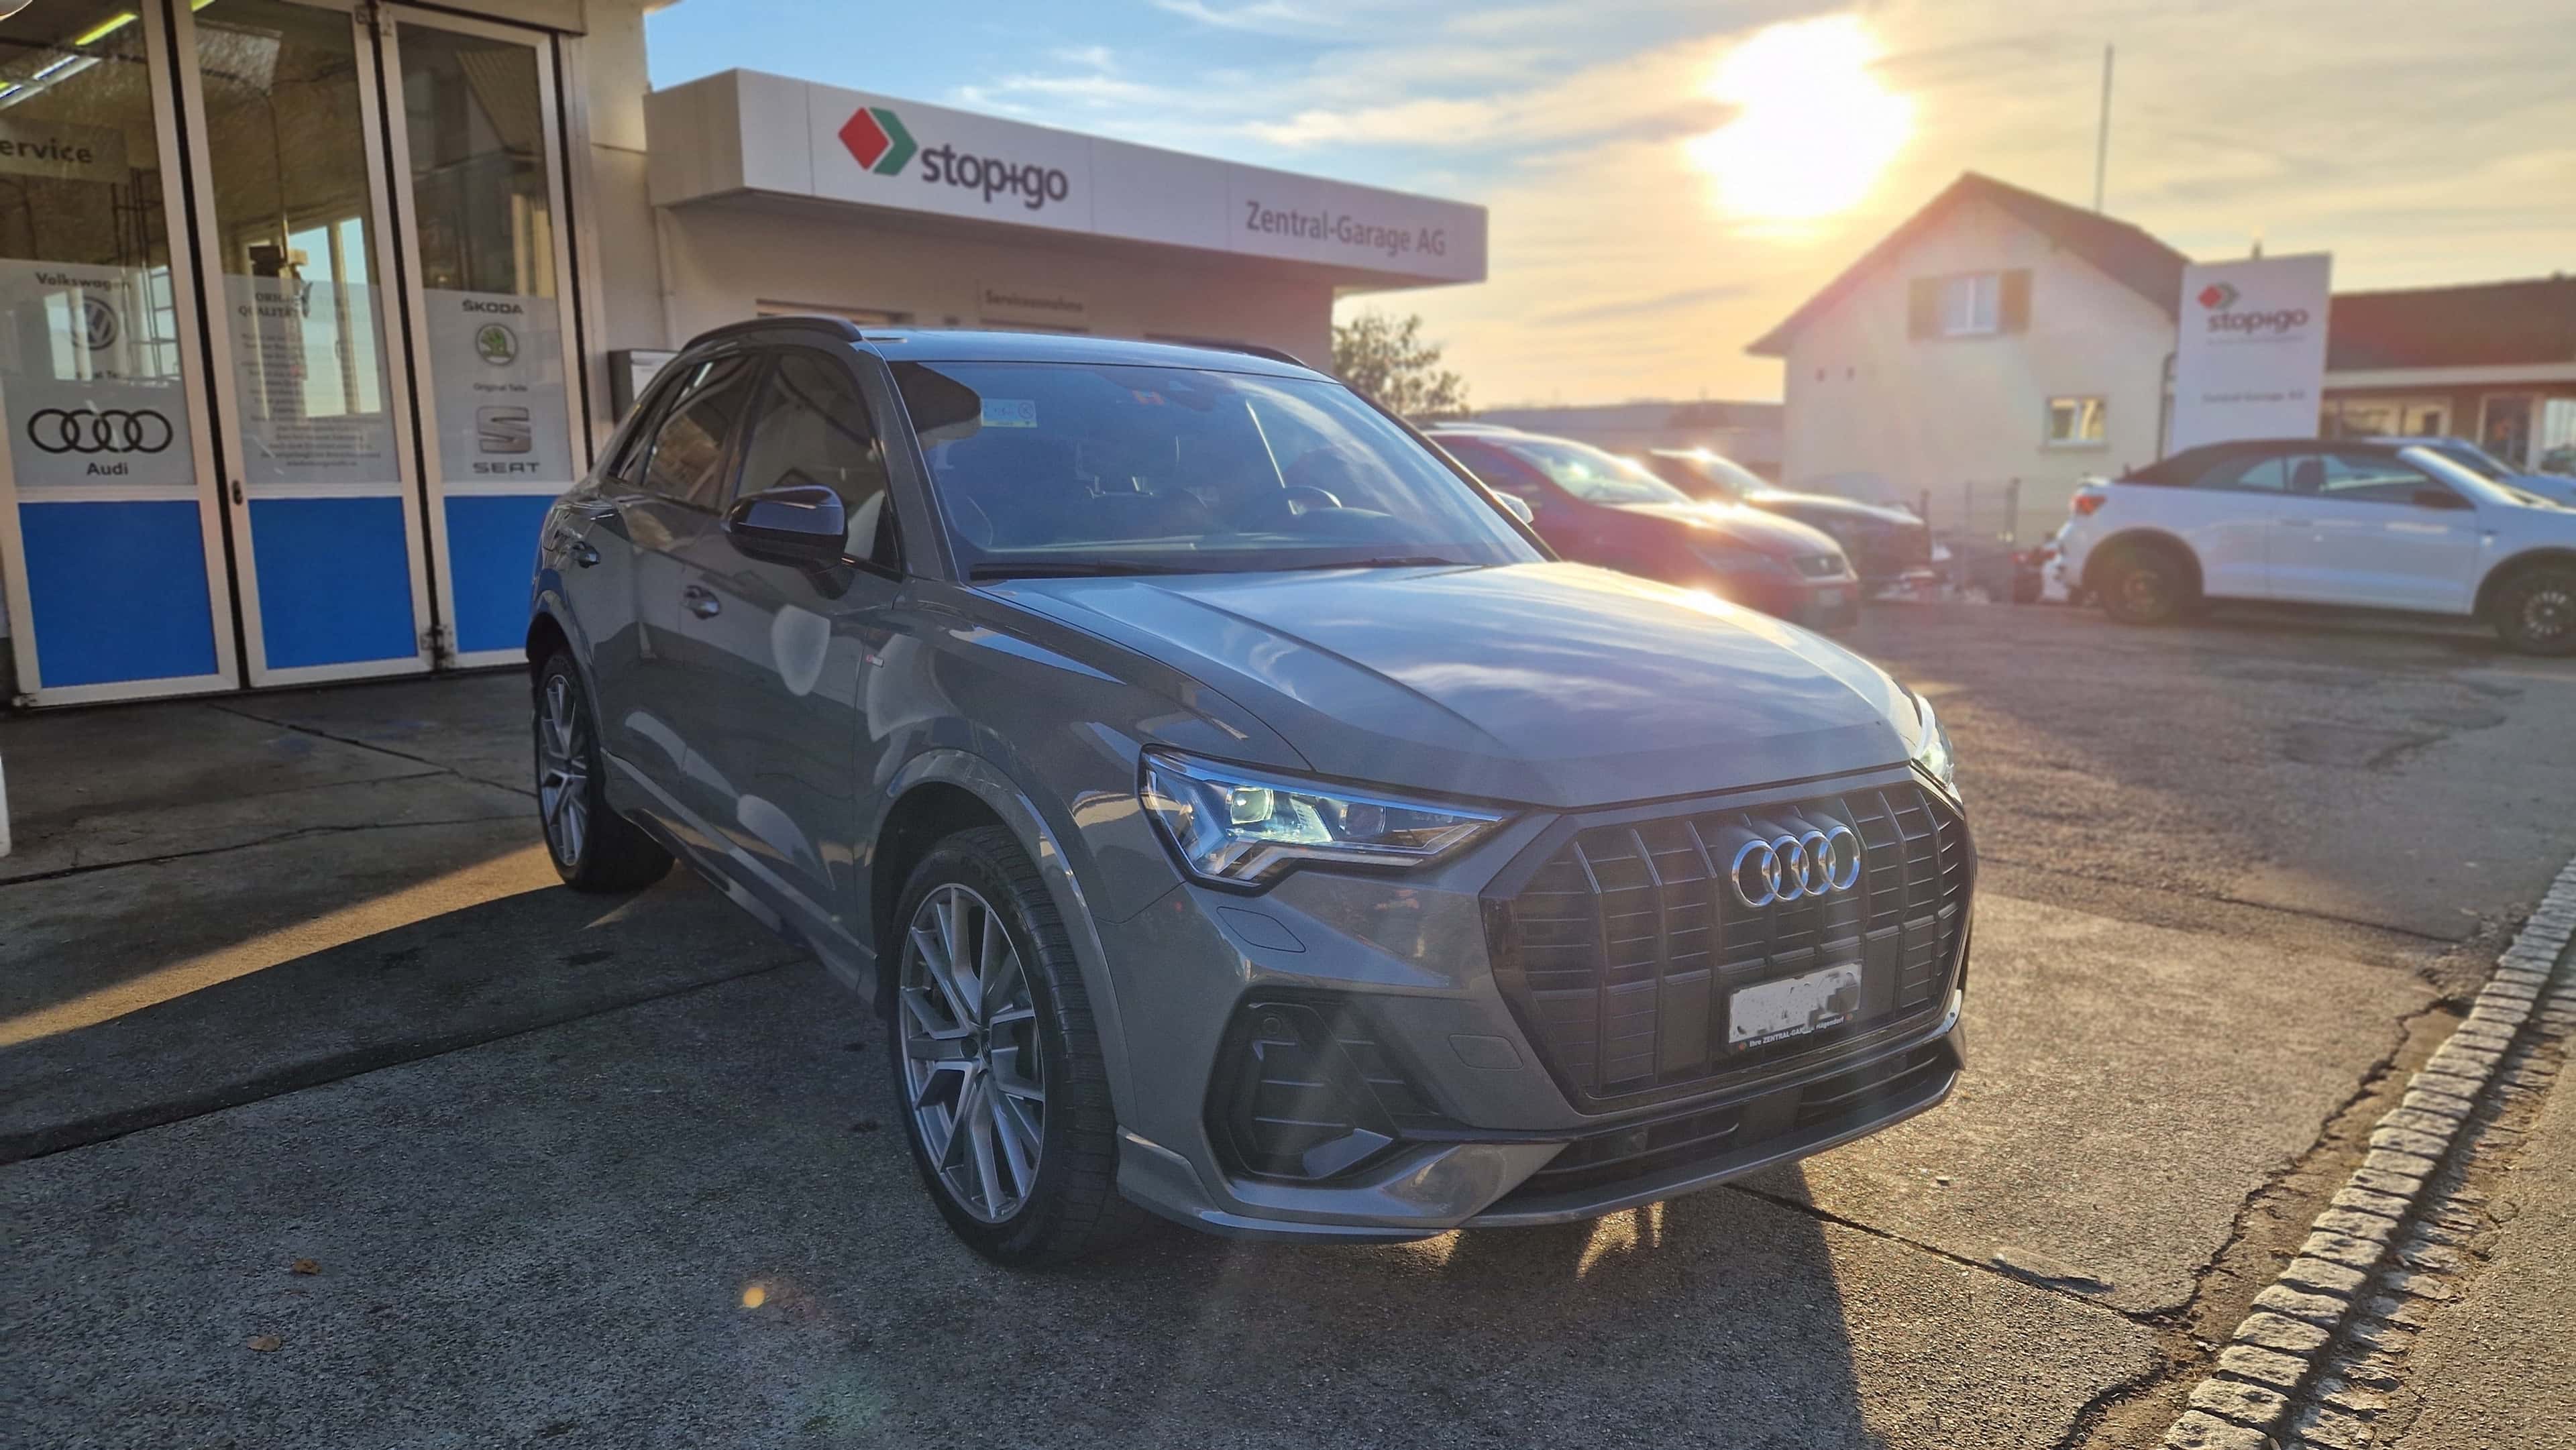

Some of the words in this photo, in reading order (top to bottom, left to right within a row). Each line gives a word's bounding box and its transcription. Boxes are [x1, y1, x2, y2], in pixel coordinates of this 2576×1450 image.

[920, 144, 1068, 210] stop+go
[1246, 201, 1412, 257] Zentral-Garage
[1416, 227, 1446, 256] AG
[462, 299, 523, 314] ŠKODA
[86, 462, 128, 476] Audi
[472, 461, 540, 475] SEAT
